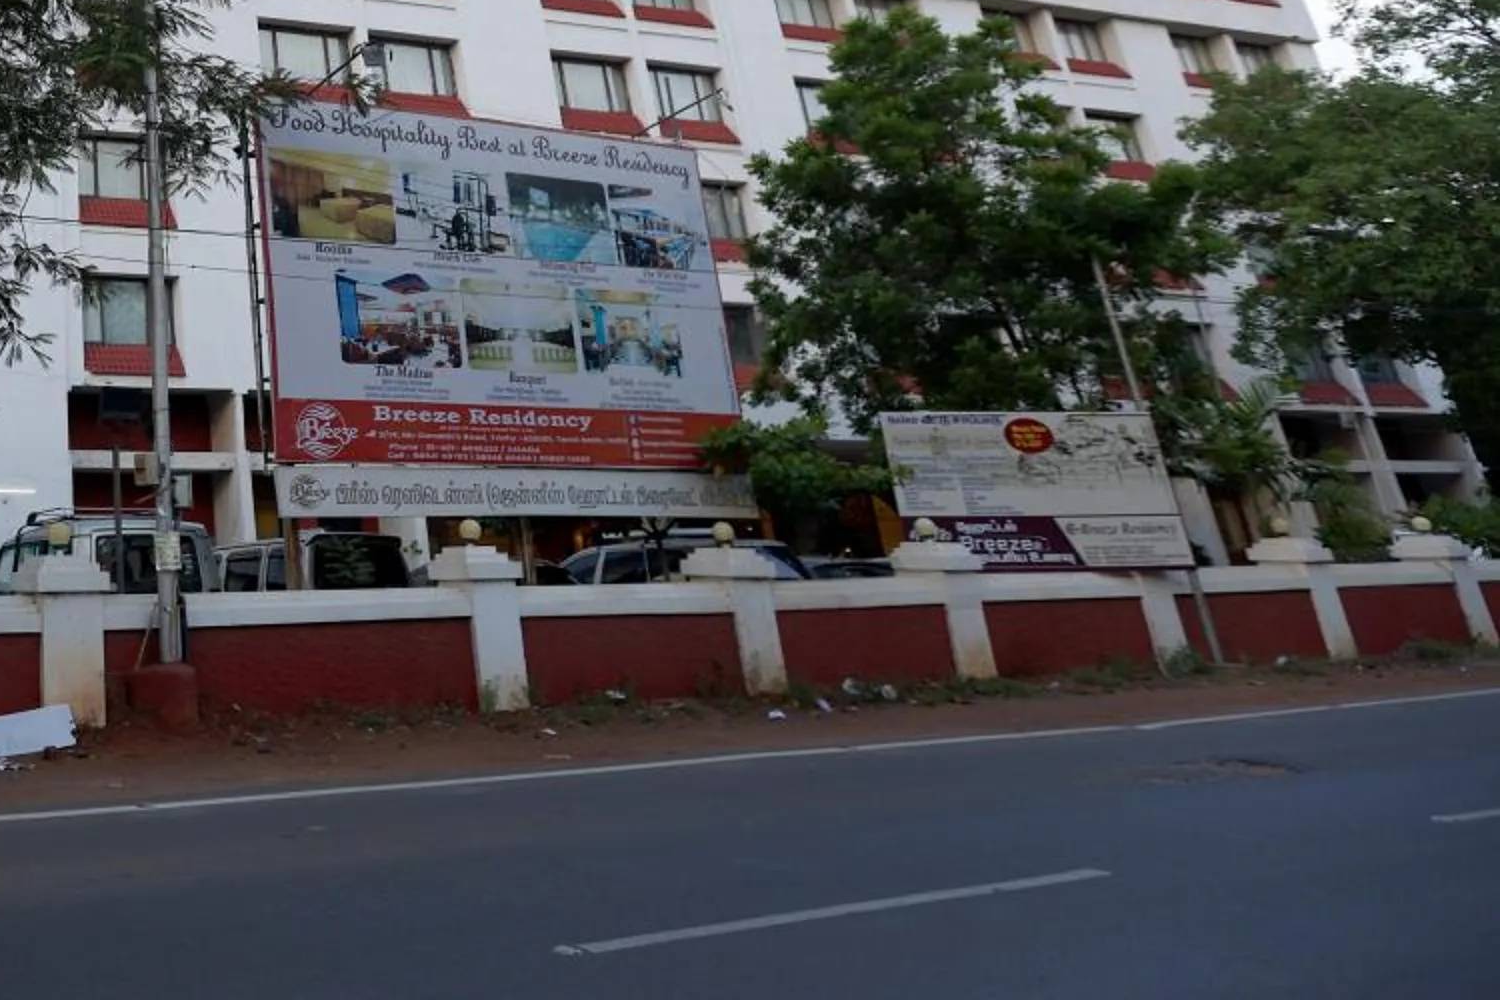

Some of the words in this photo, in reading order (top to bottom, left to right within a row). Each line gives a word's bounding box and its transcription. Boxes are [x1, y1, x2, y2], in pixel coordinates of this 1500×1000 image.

[331, 109, 451, 160] Hospitality
[457, 125, 503, 153] Best
[508, 137, 528, 156] at
[532, 134, 600, 167] Breeze
[603, 144, 692, 189] Residency
[372, 405, 461, 423] Breeze
[467, 408, 592, 433] Residency
[959, 535, 1033, 552] Breeze
